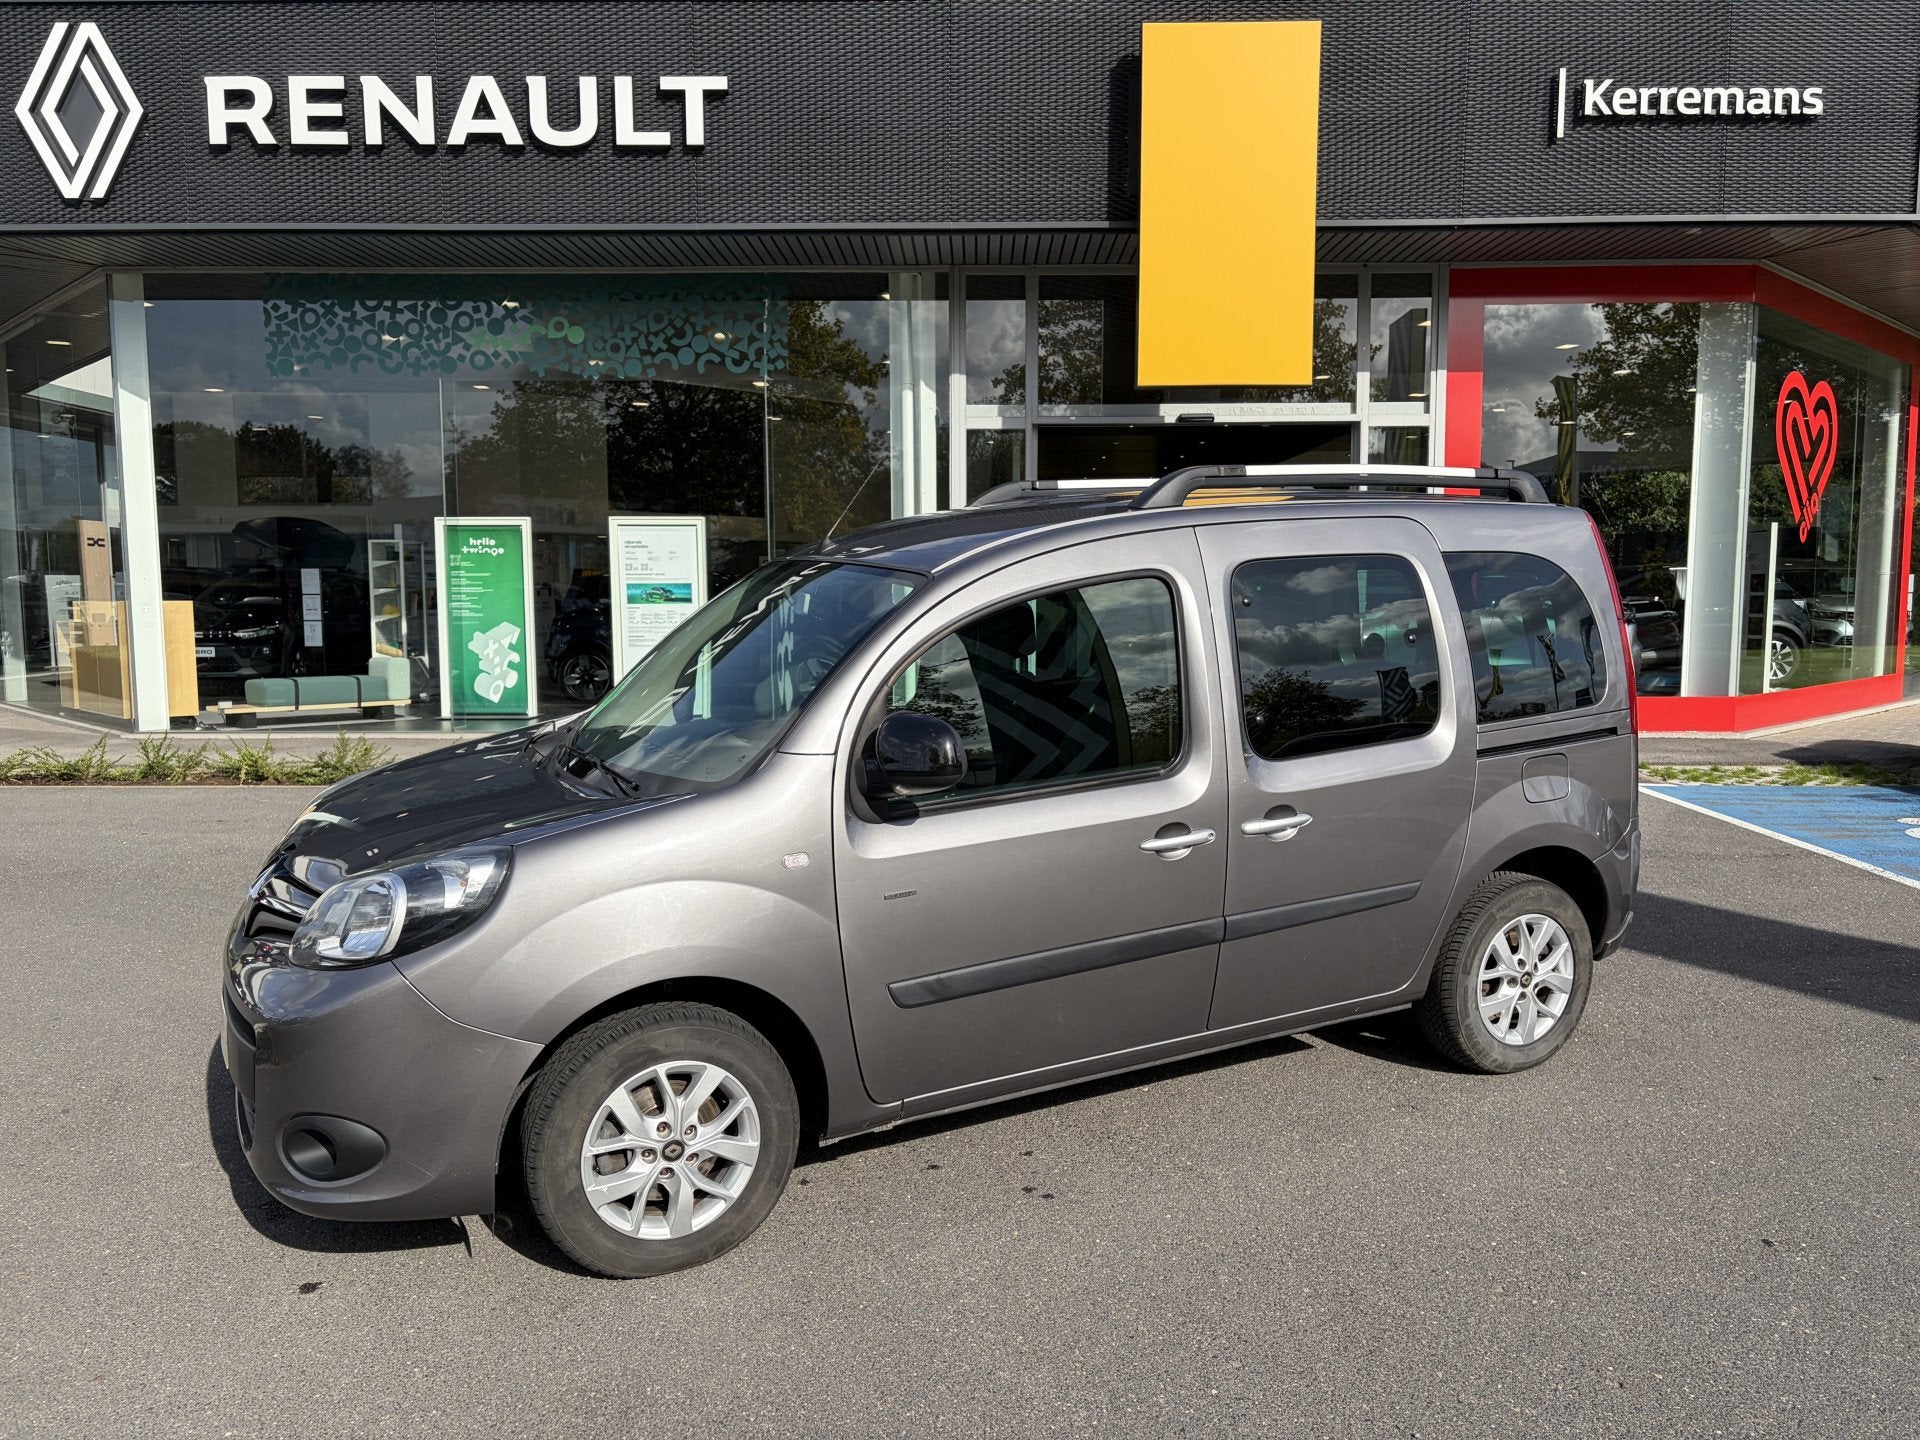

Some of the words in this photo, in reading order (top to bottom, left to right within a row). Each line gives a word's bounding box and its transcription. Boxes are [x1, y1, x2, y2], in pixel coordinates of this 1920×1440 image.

[1583, 79, 1824, 115] Kerremans
[204, 75, 728, 147] RENAULT
[461, 545, 505, 557] twingo
[469, 537, 496, 545] hello
